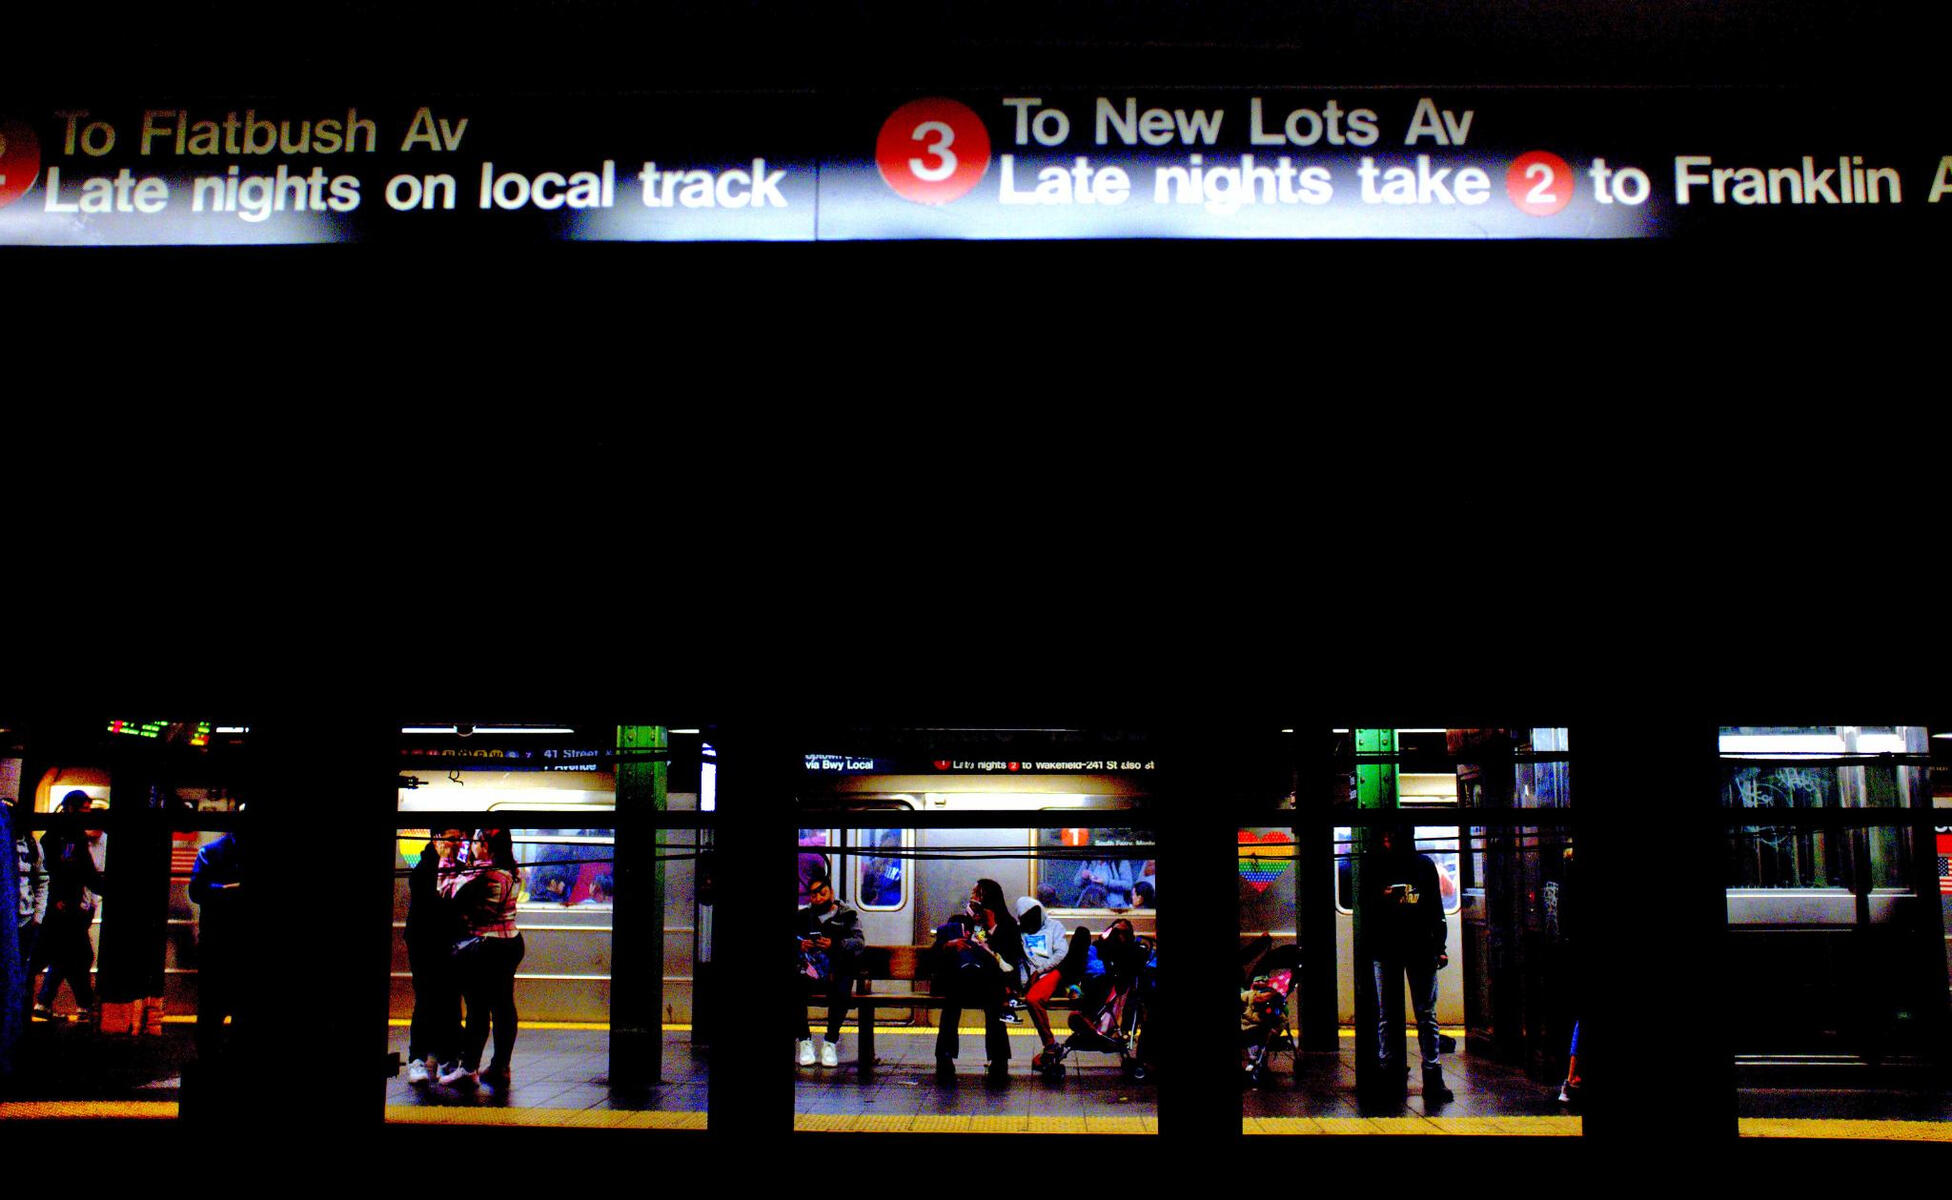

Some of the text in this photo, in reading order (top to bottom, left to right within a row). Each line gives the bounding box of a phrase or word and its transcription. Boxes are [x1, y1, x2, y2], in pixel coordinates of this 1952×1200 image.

[55, 107, 116, 157] To
[140, 106, 377, 156] Flatbush
[401, 105, 470, 152] Av
[1003, 97, 1475, 147] To New Lots Av
[907, 120, 959, 183] 3
[44, 158, 788, 223] Late nights on local track
[1000, 153, 1131, 206] Late
[1154, 153, 1334, 216] nights
[1358, 154, 1491, 205] take
[1524, 163, 1557, 204] 2
[1590, 157, 1651, 205] to
[1674, 156, 1902, 205] Franklin
[543, 749, 558, 759] 41
[562, 749, 598, 758] Street
[804, 759, 874, 771] via Bwy Local
[977, 760, 1007, 772] nights
[1022, 760, 1033, 769] to
[1106, 760, 1118, 770] St
